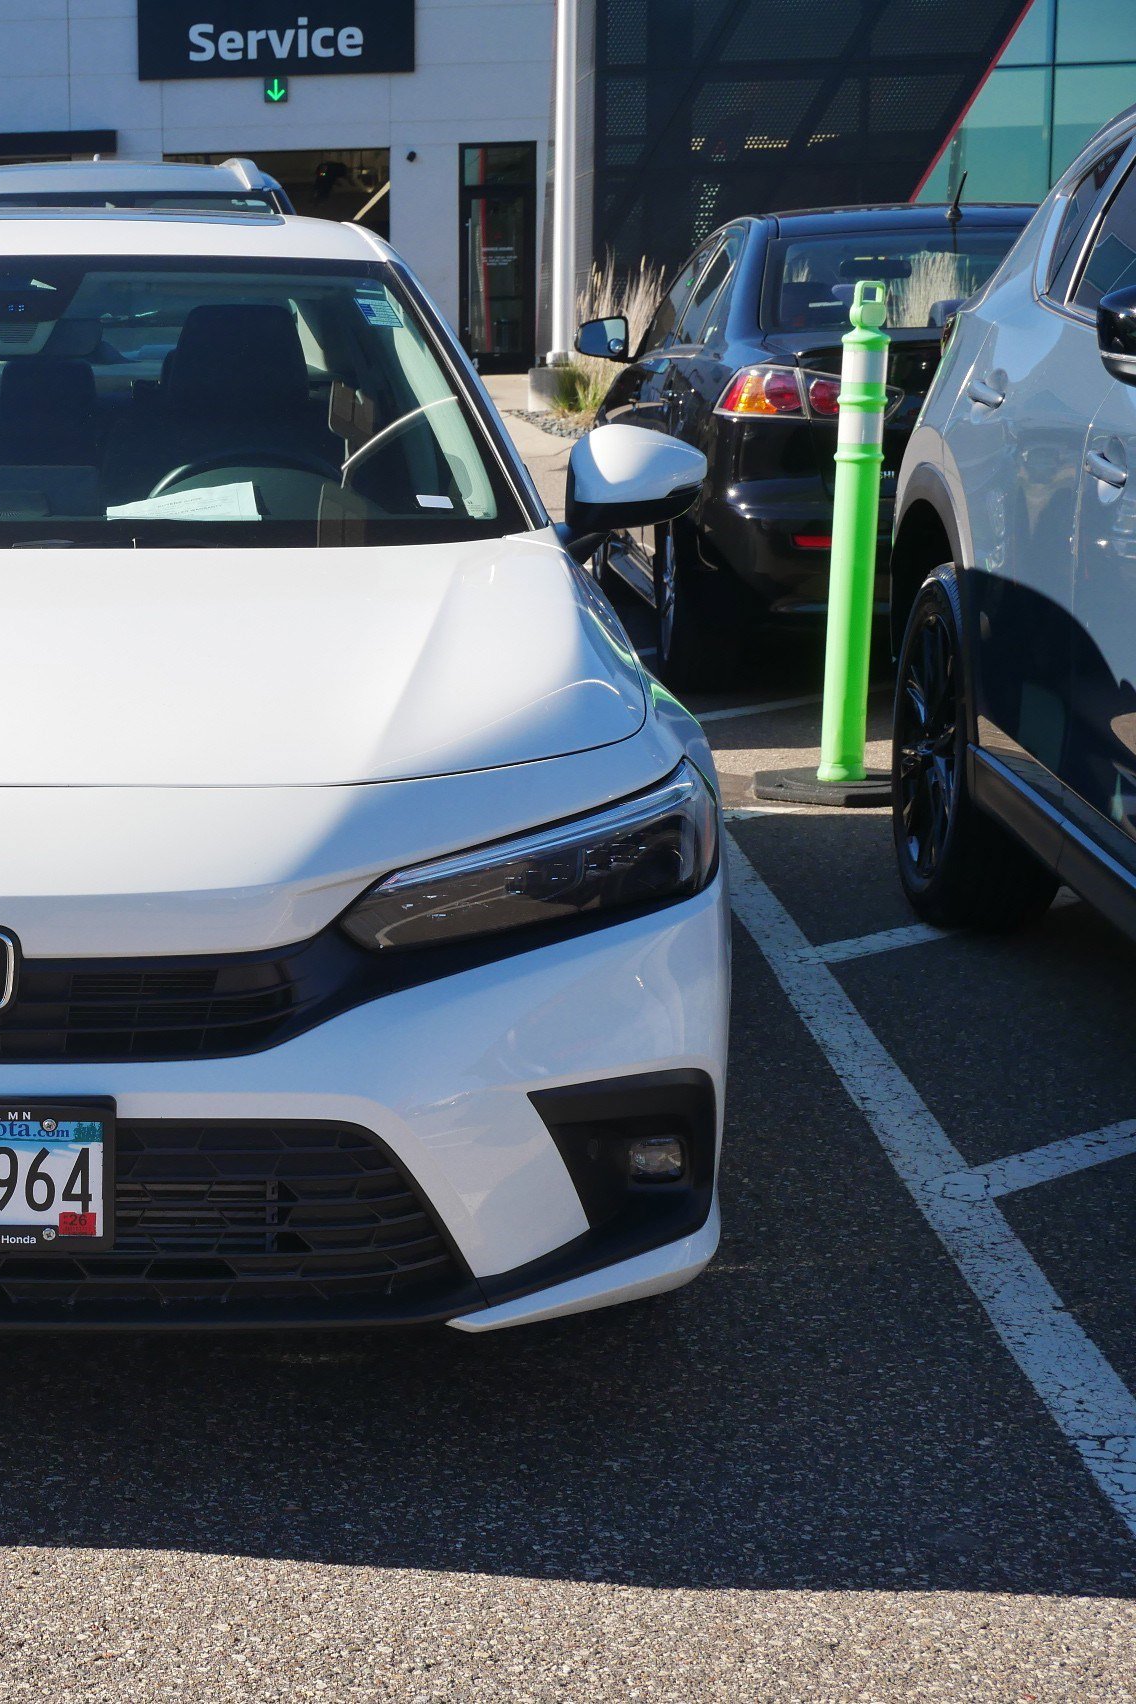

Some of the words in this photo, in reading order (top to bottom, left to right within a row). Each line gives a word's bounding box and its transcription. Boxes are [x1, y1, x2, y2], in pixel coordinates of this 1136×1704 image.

[188, 16, 364, 62] Service
[8, 1111, 31, 1120] MN
[69, 1214, 87, 1226] 26
[1, 1234, 37, 1245] Honda
